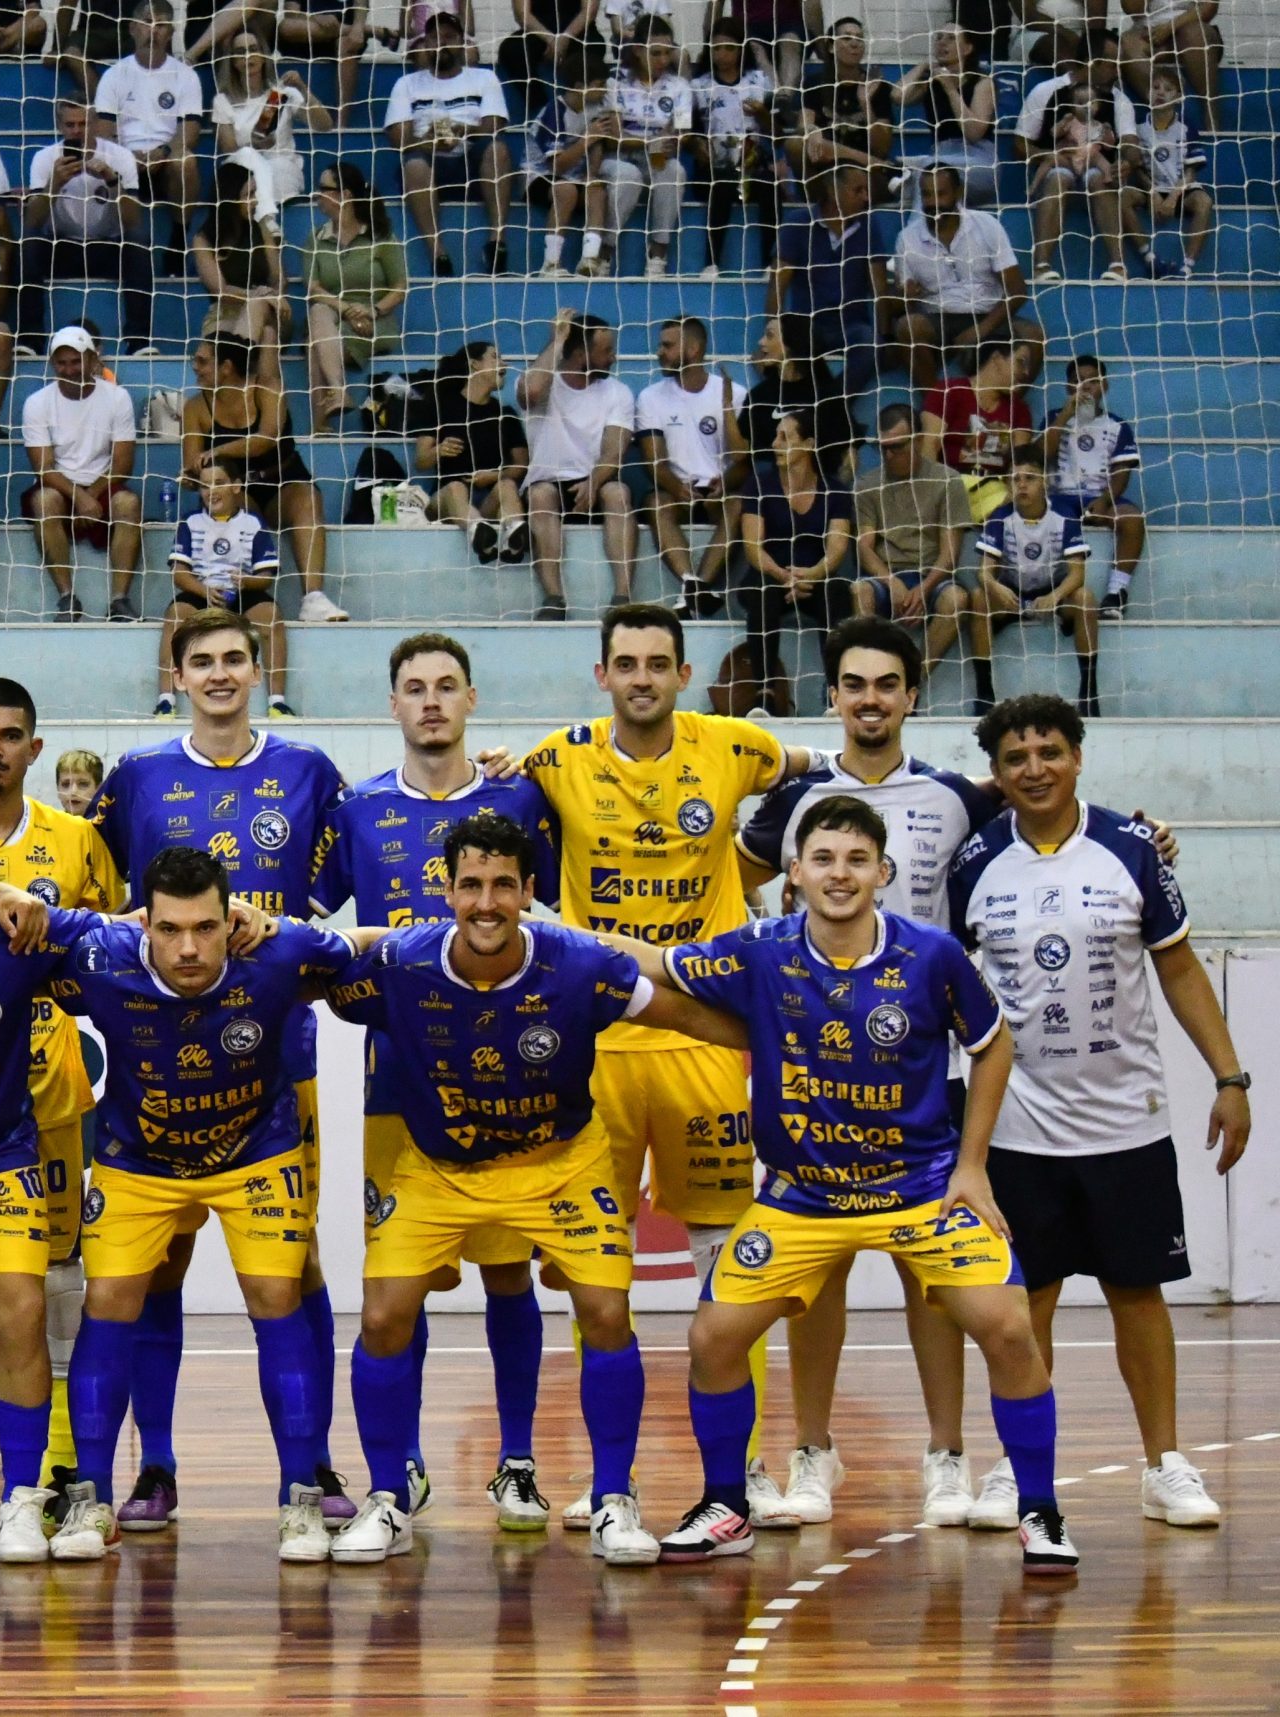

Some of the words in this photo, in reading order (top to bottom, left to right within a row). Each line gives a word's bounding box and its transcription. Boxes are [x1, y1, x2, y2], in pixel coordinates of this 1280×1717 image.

[162, 791, 196, 801] CRIATIVA
[254, 787, 285, 798] MEGA
[375, 816, 408, 828] CRIATIVA
[26, 854, 55, 864] MEGA
[680, 953, 746, 980] TIROL
[873, 977, 907, 989] MEGA
[220, 995, 253, 1007] MEGA
[515, 1004, 549, 1013] MEGA
[170, 1079, 262, 1113] SCHERER
[809, 1077, 903, 1103] SCHERER
[717, 1110, 750, 1148] 30
[809, 1121, 904, 1146] SICOOB
[688, 1157, 720, 1168] AABB
[15, 1167, 45, 1199] 10
[279, 1165, 303, 1199] 17
[591, 1186, 619, 1215] 6
[251, 1206, 284, 1218] AABB
